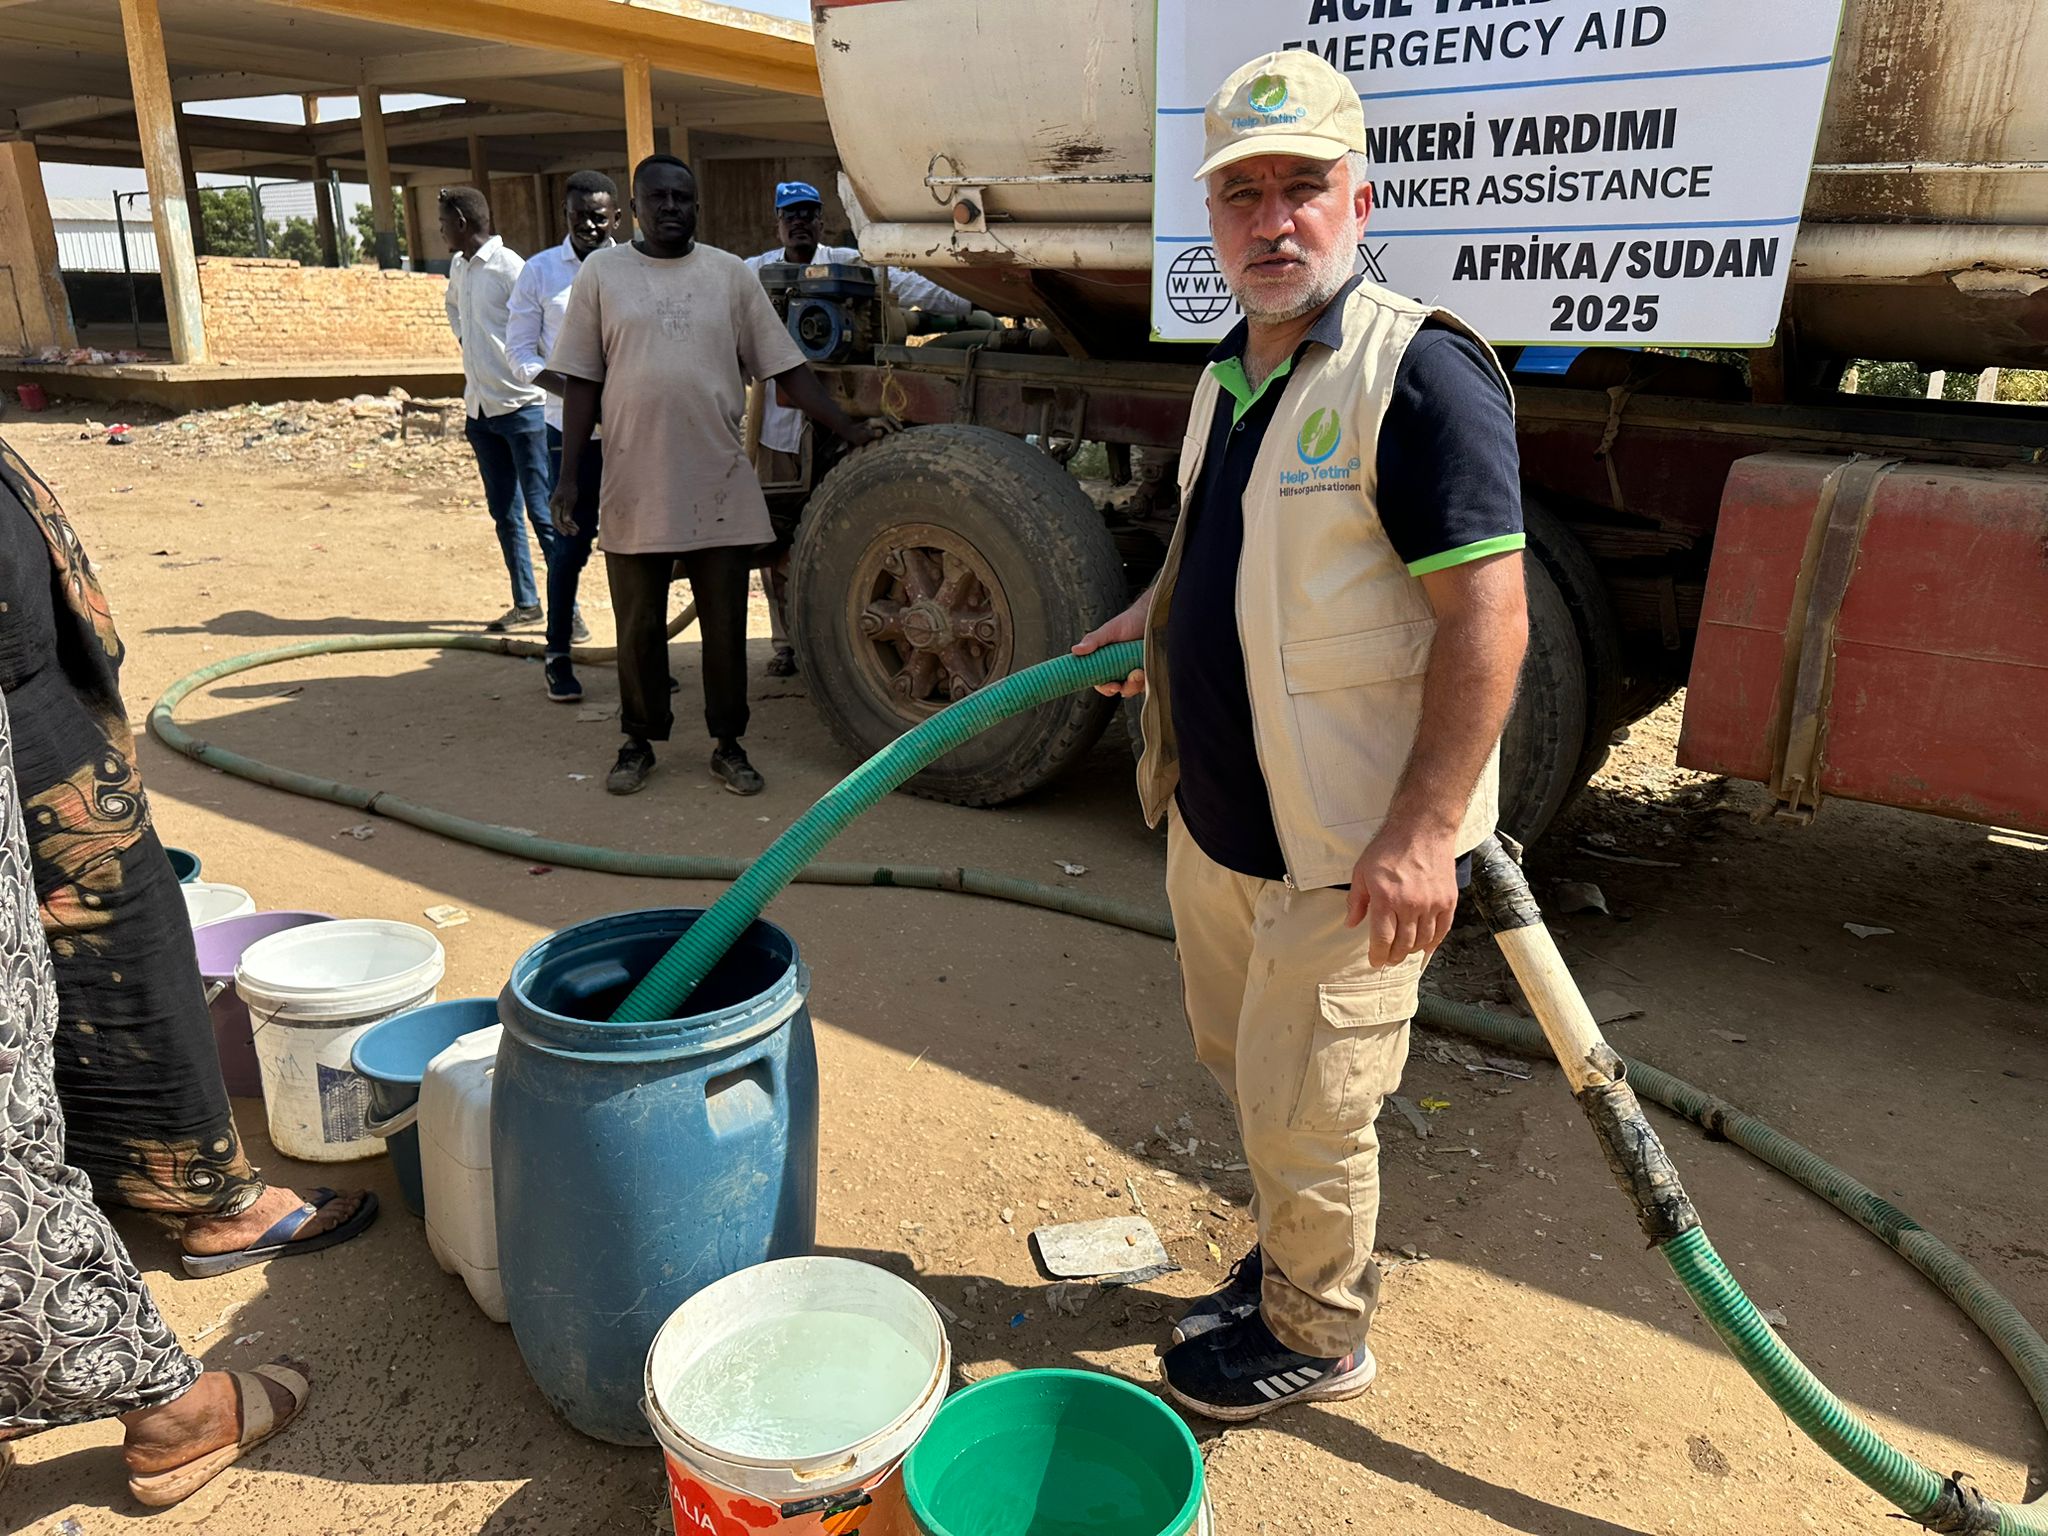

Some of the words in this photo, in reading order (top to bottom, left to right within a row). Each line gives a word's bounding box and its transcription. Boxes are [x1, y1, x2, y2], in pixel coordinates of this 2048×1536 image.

[1283, 16, 1565, 72] MERGENCY
[1574, 5, 1667, 53] AID
[1488, 107, 1678, 158] YARDIMI
[1452, 234, 1779, 283] AFRİKA/SUDAN
[1550, 294, 1660, 332] 2025
[1280, 469, 1309, 486] Help
[1311, 465, 1350, 481] Yetim
